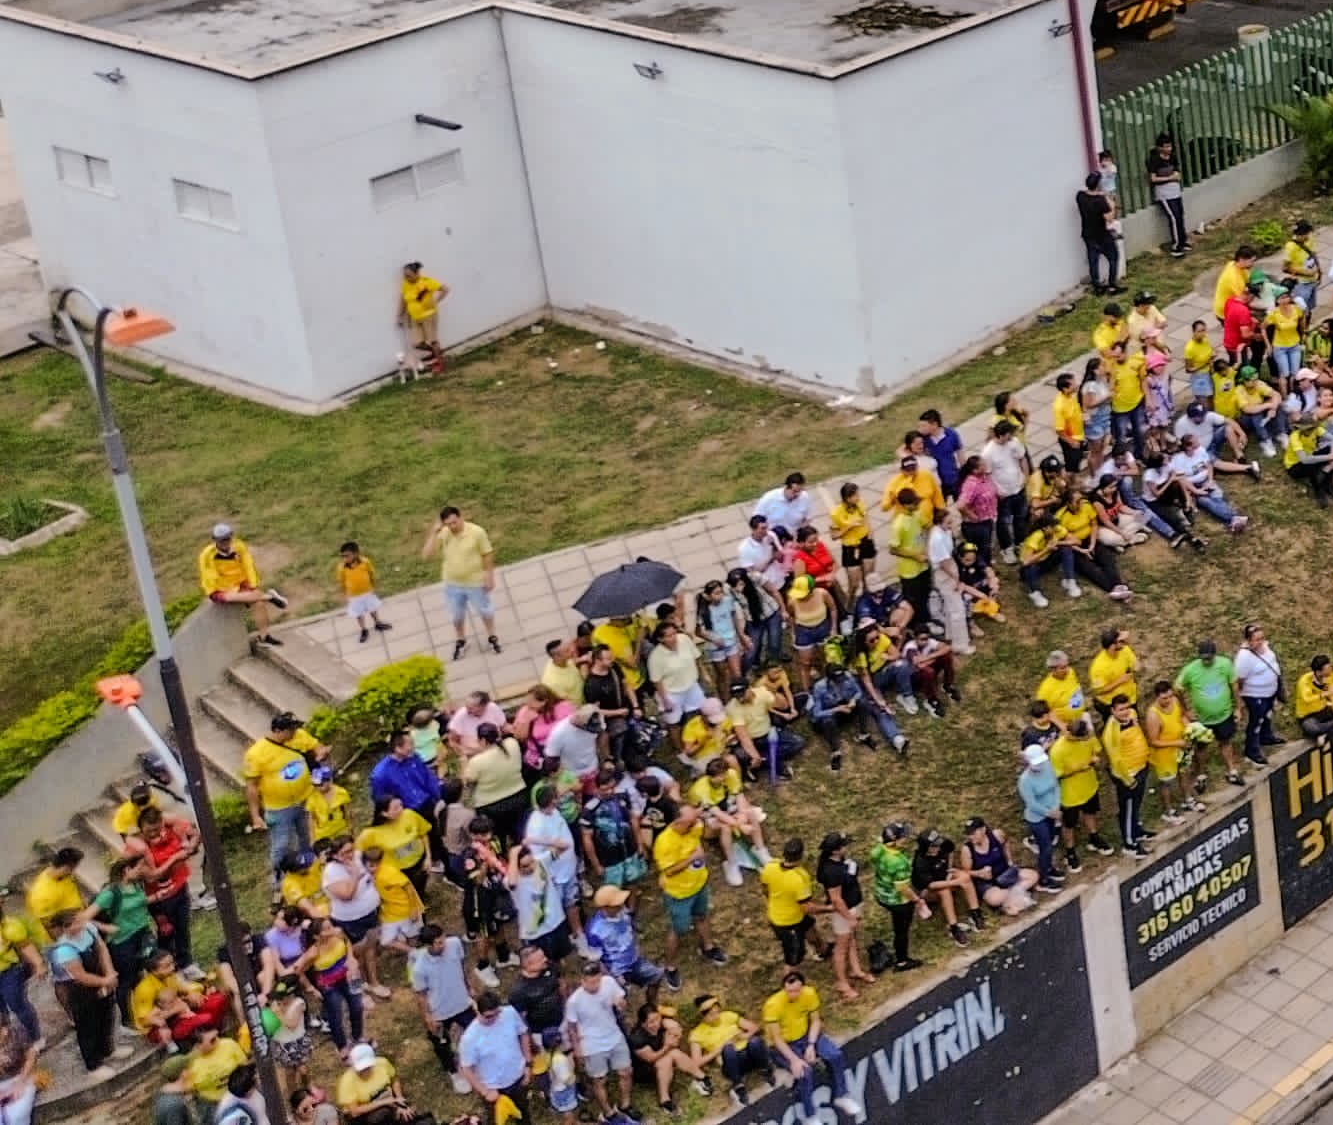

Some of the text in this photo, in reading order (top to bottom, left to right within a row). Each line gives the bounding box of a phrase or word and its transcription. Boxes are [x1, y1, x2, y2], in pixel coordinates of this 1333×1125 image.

[1130, 817, 1249, 904] COMPRO NEVERAS
[1148, 887, 1247, 962] SERVICIO TECNICO
[872, 980, 1005, 1105] VITRIN
